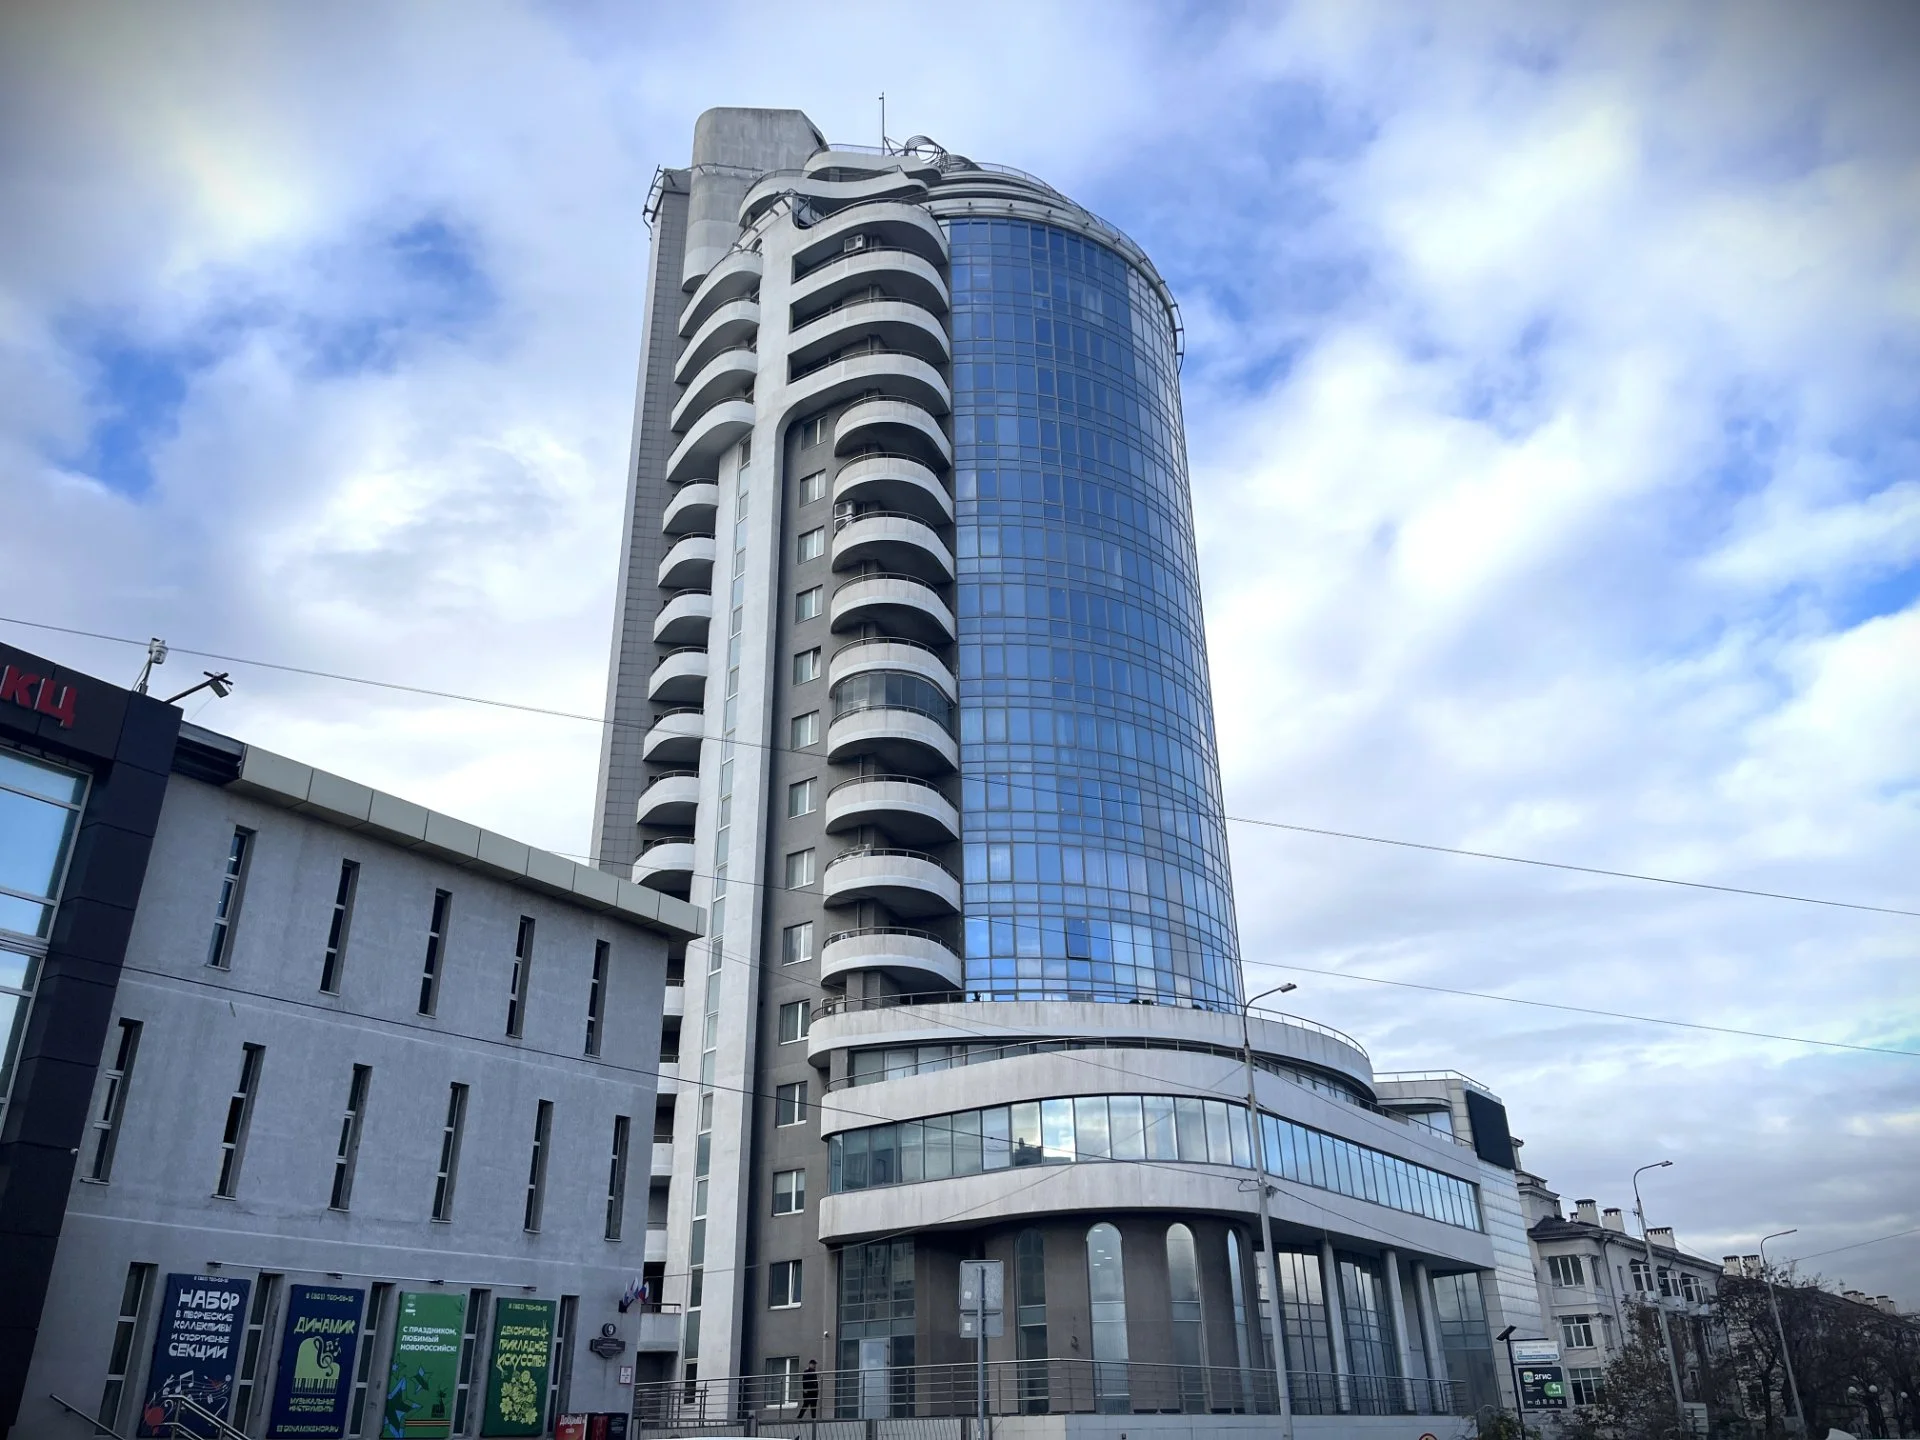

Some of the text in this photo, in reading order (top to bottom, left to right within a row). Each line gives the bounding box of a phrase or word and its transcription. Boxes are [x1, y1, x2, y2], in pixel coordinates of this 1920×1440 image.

[178, 1288, 240, 1311] НАБОР
[175, 1309, 235, 1322] В ТВОРЧЕСКИЕ
[173, 1319, 233, 1333] КОЛЛЕКТИВЫ
[293, 1316, 356, 1335] ДИНАМИК
[408, 1326, 457, 1336] ПРАЗДНИКОМ,
[170, 1332, 230, 1344] И СПОРТИВНЫЕ
[401, 1334, 440, 1343] ЛЮБИМЫЙ
[168, 1342, 229, 1362] СЕКЦИИ
[400, 1344, 457, 1352] НОВОРОССИЙСК!
[499, 1338, 548, 1353] ПРИКЛАДНОЕ
[496, 1353, 547, 1370] ИСКУССТВО
